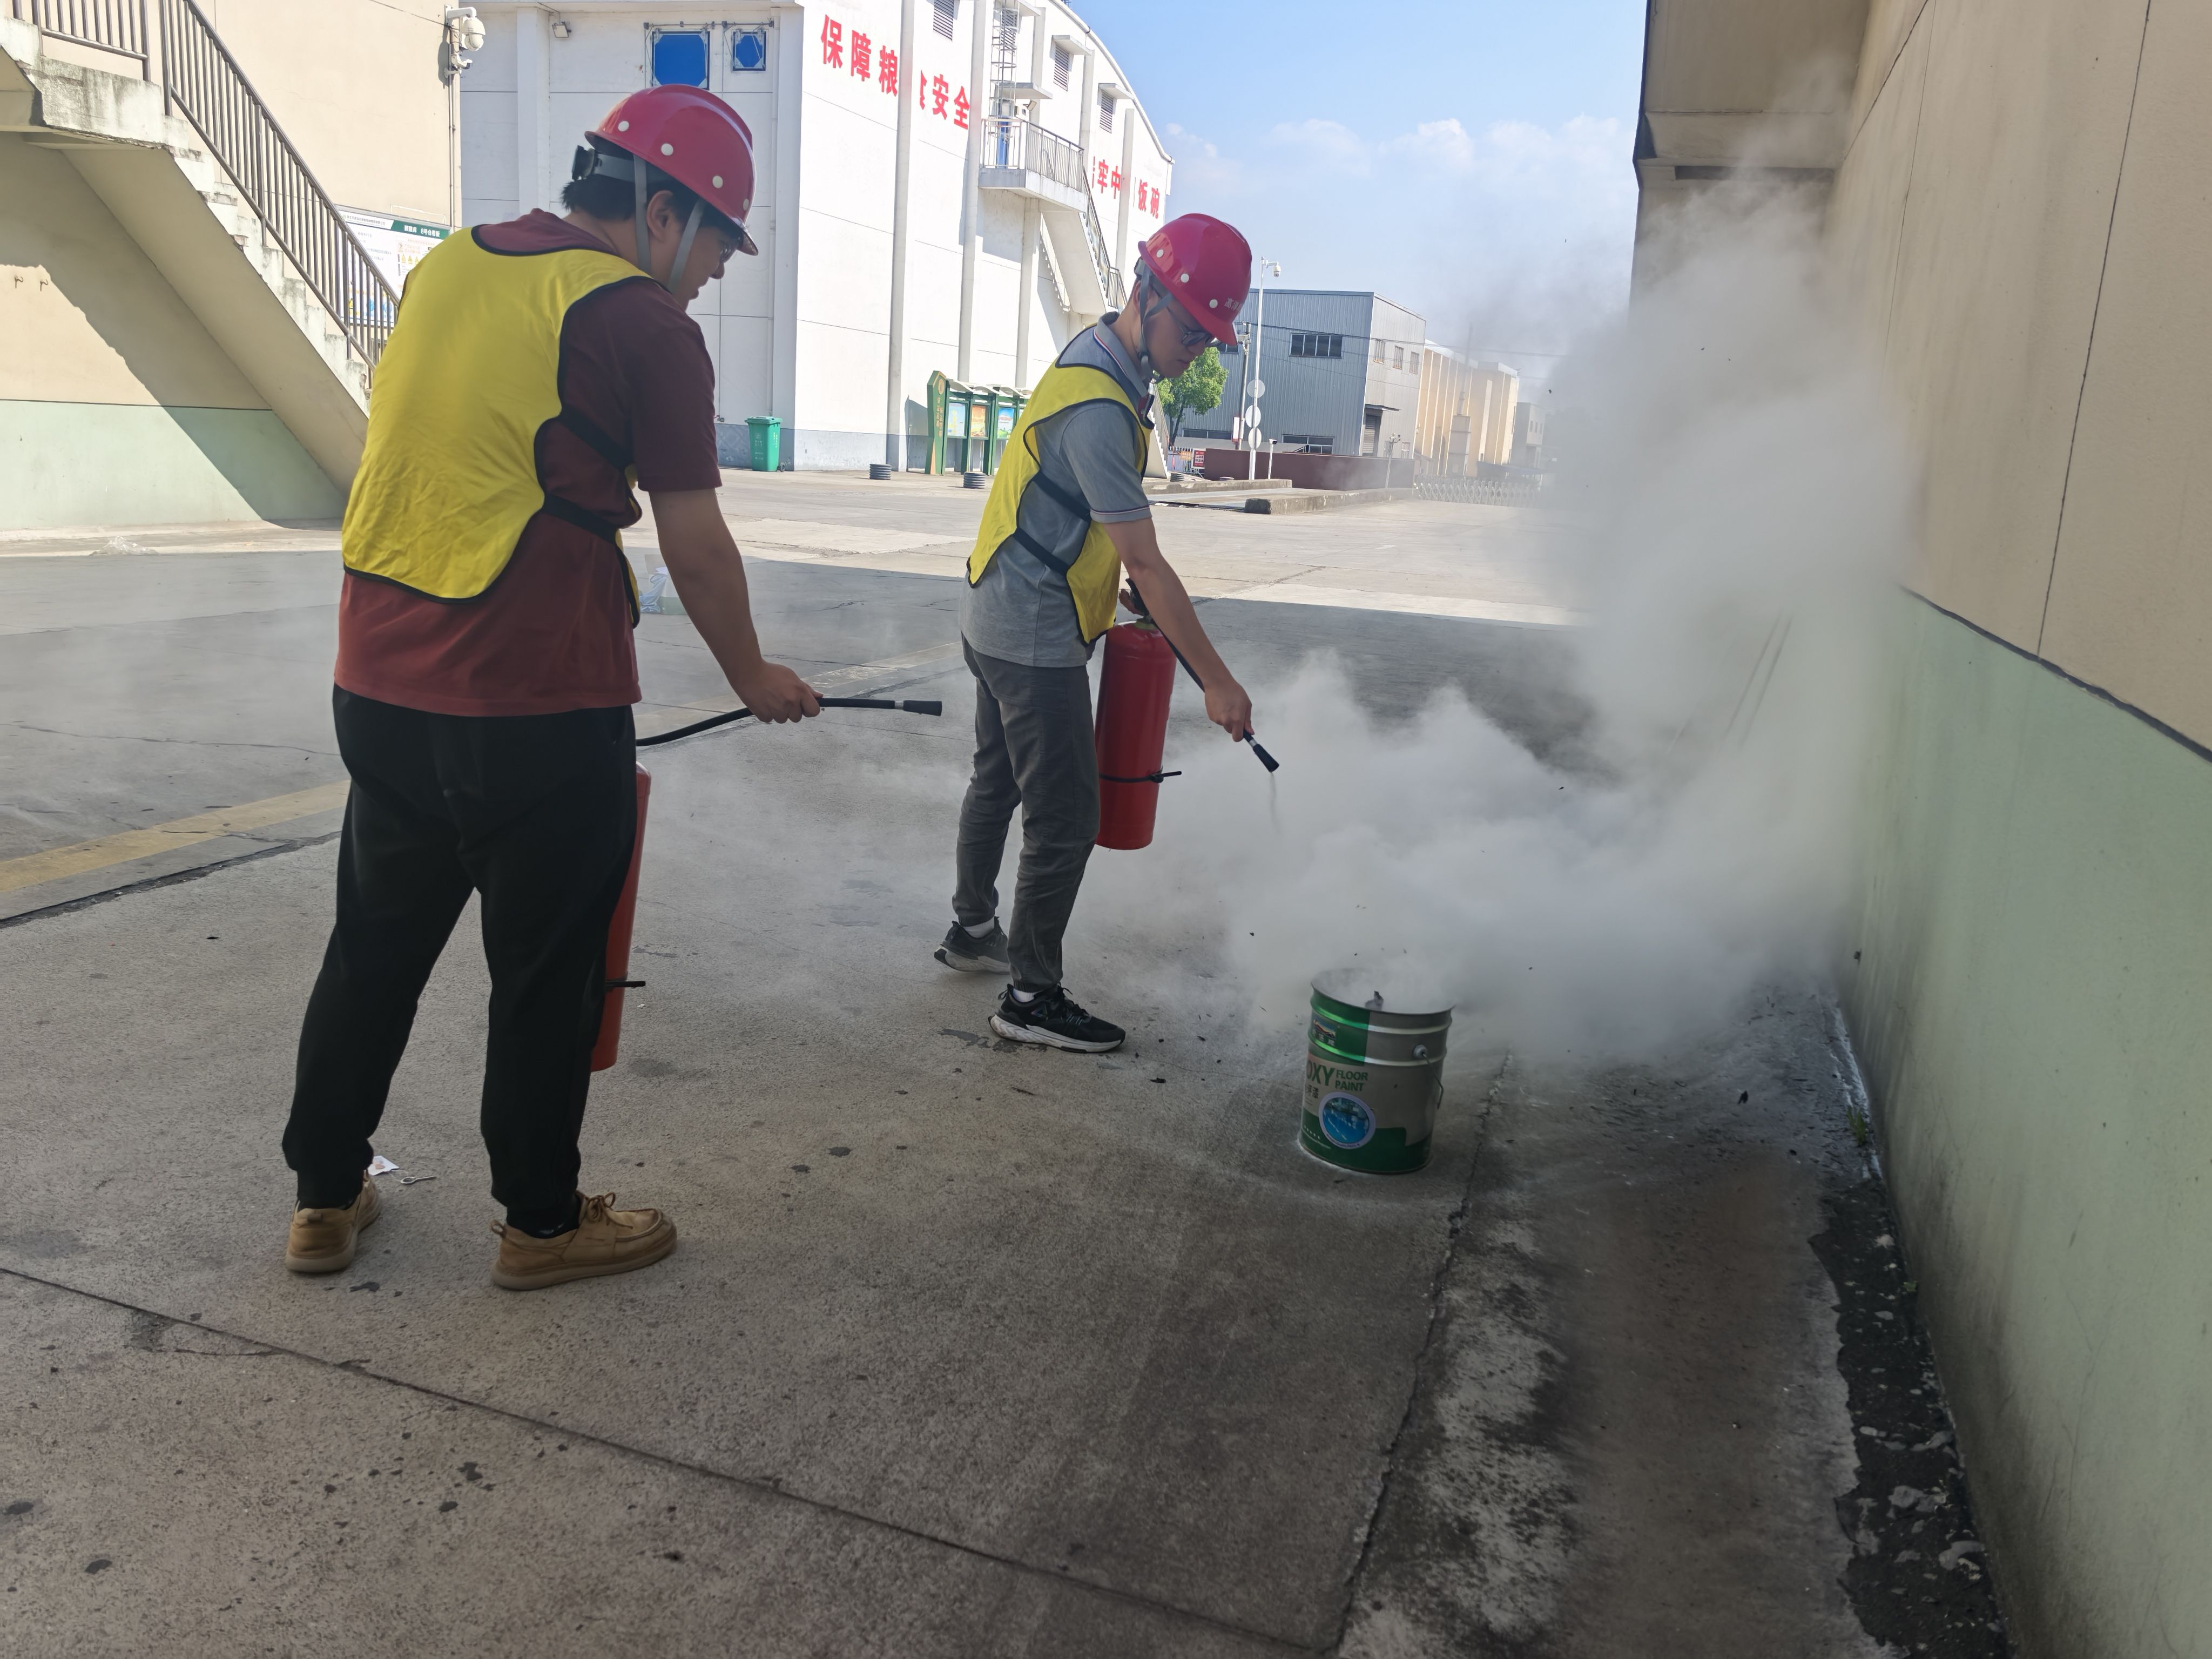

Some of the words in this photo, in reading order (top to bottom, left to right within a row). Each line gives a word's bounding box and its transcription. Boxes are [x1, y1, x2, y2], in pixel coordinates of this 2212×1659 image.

[1092, 156, 1160, 219] 牢中饭碗
[1336, 1069, 1368, 1081] FLOOR
[1335, 1080, 1365, 1091] PAINT
